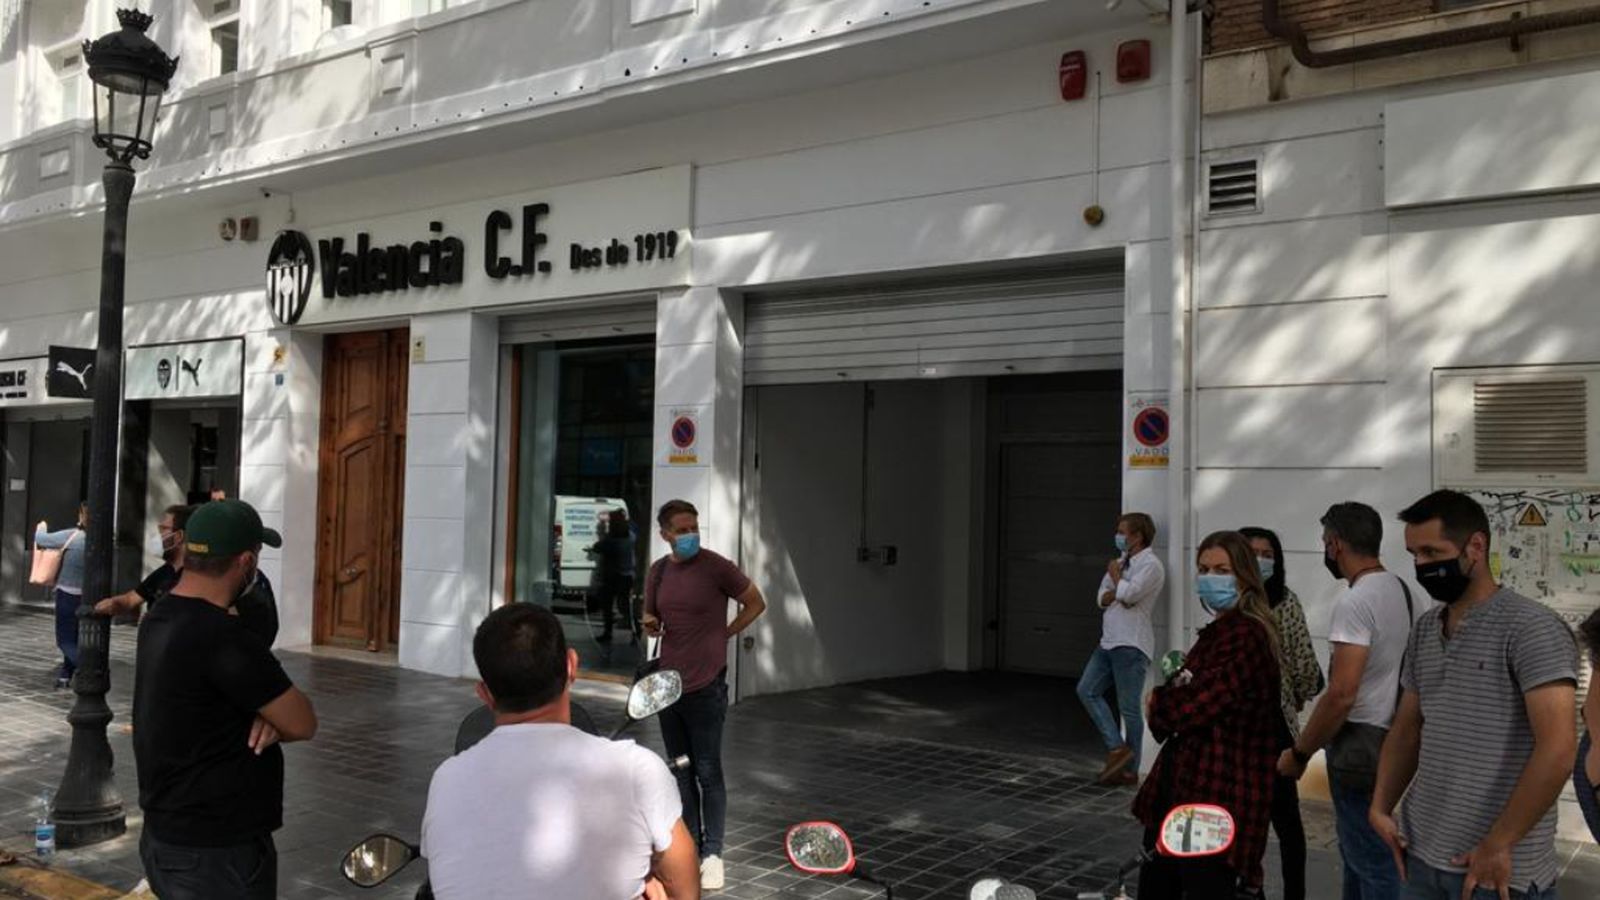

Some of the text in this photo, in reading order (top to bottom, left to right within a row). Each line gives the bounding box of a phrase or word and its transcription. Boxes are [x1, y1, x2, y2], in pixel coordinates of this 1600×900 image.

[319, 203, 551, 298] Valencia C.F.
[570, 230, 678, 270] Des de 1919
